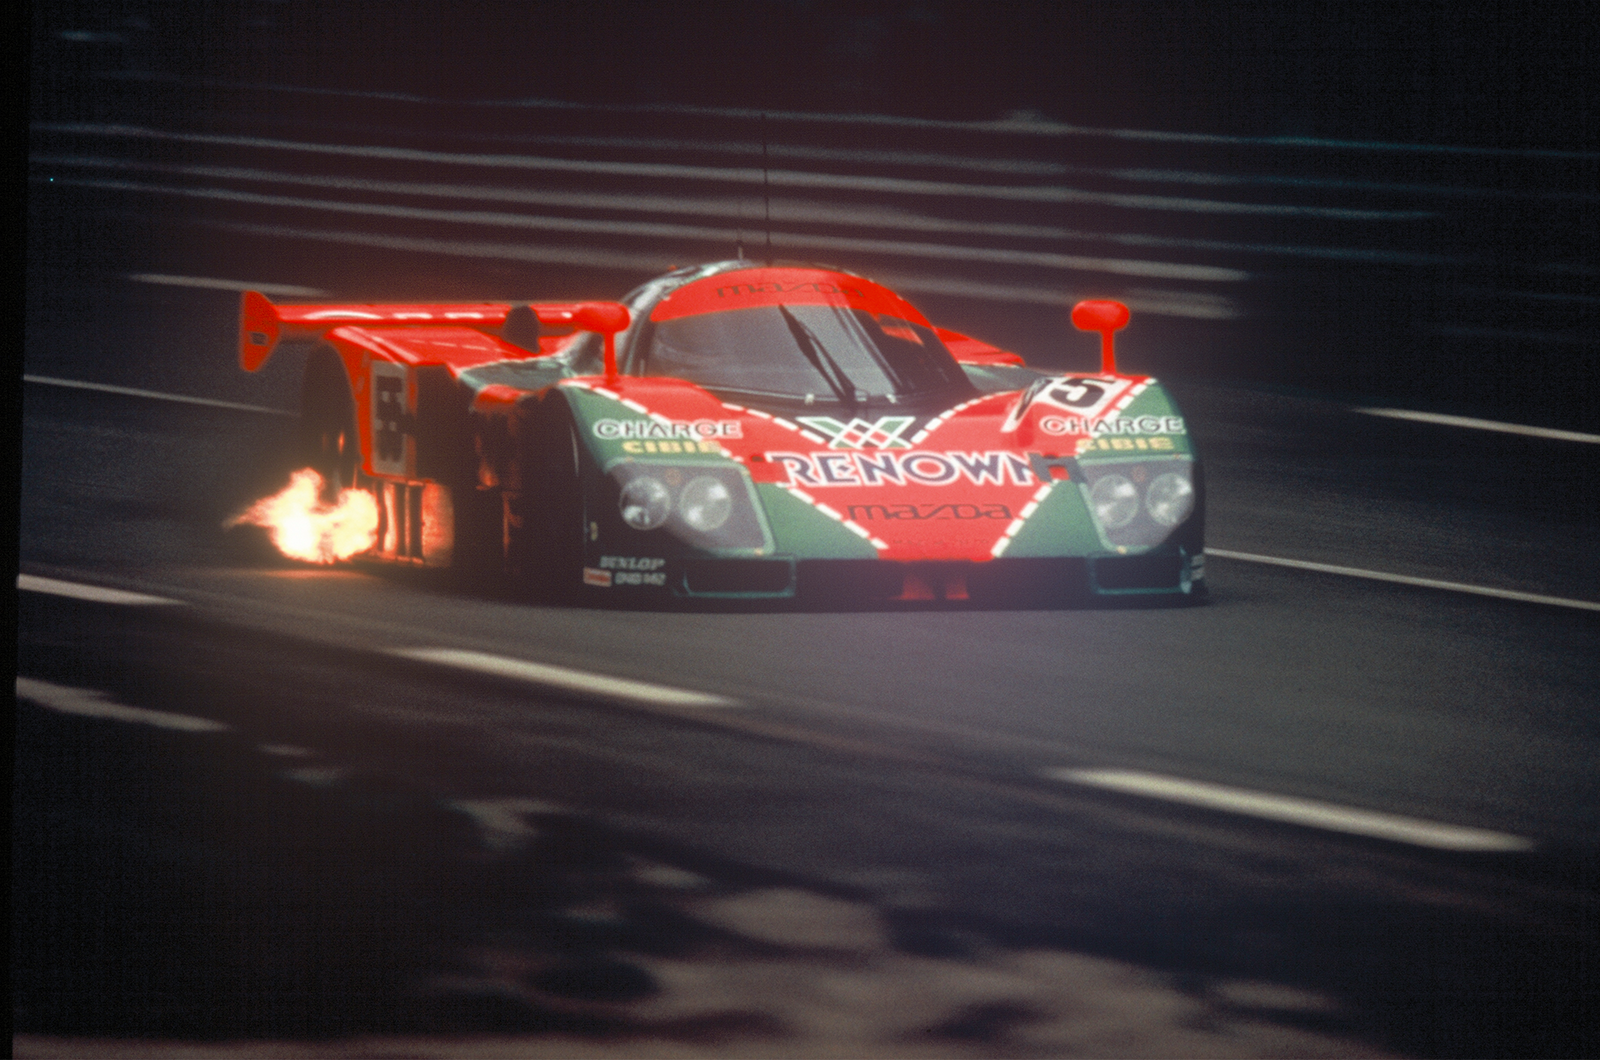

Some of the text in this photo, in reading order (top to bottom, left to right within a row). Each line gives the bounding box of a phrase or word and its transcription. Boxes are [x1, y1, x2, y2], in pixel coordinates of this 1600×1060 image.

[592, 418, 743, 440] CHARGE
[1040, 415, 1187, 436] CHARGE
[846, 504, 1013, 520] mazda
